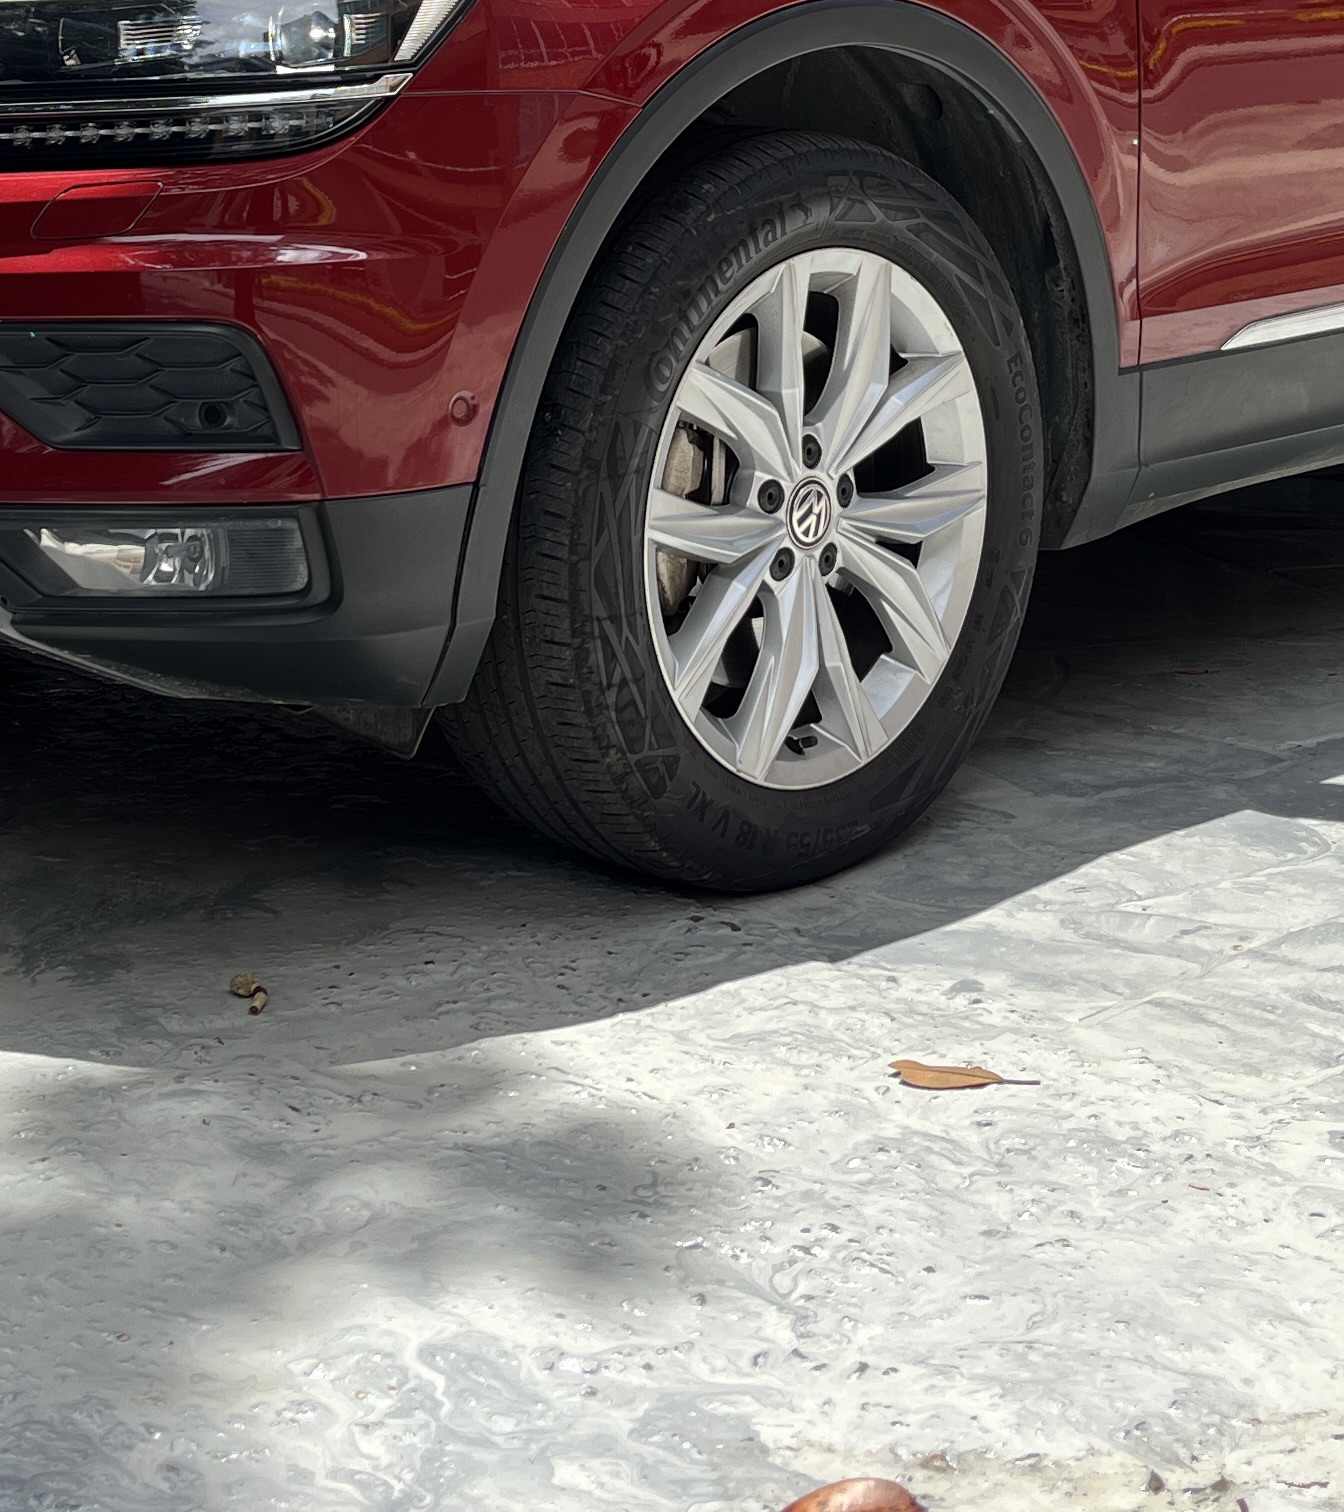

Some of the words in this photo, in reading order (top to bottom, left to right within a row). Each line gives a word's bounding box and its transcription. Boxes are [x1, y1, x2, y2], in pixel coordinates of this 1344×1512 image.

[644, 200, 787, 403] Continental
[1006, 351, 1035, 521] EcoContact
[1018, 526, 1033, 547] 6
[686, 780, 715, 823] XL
[710, 808, 730, 839] V
[735, 819, 758, 850] 18
